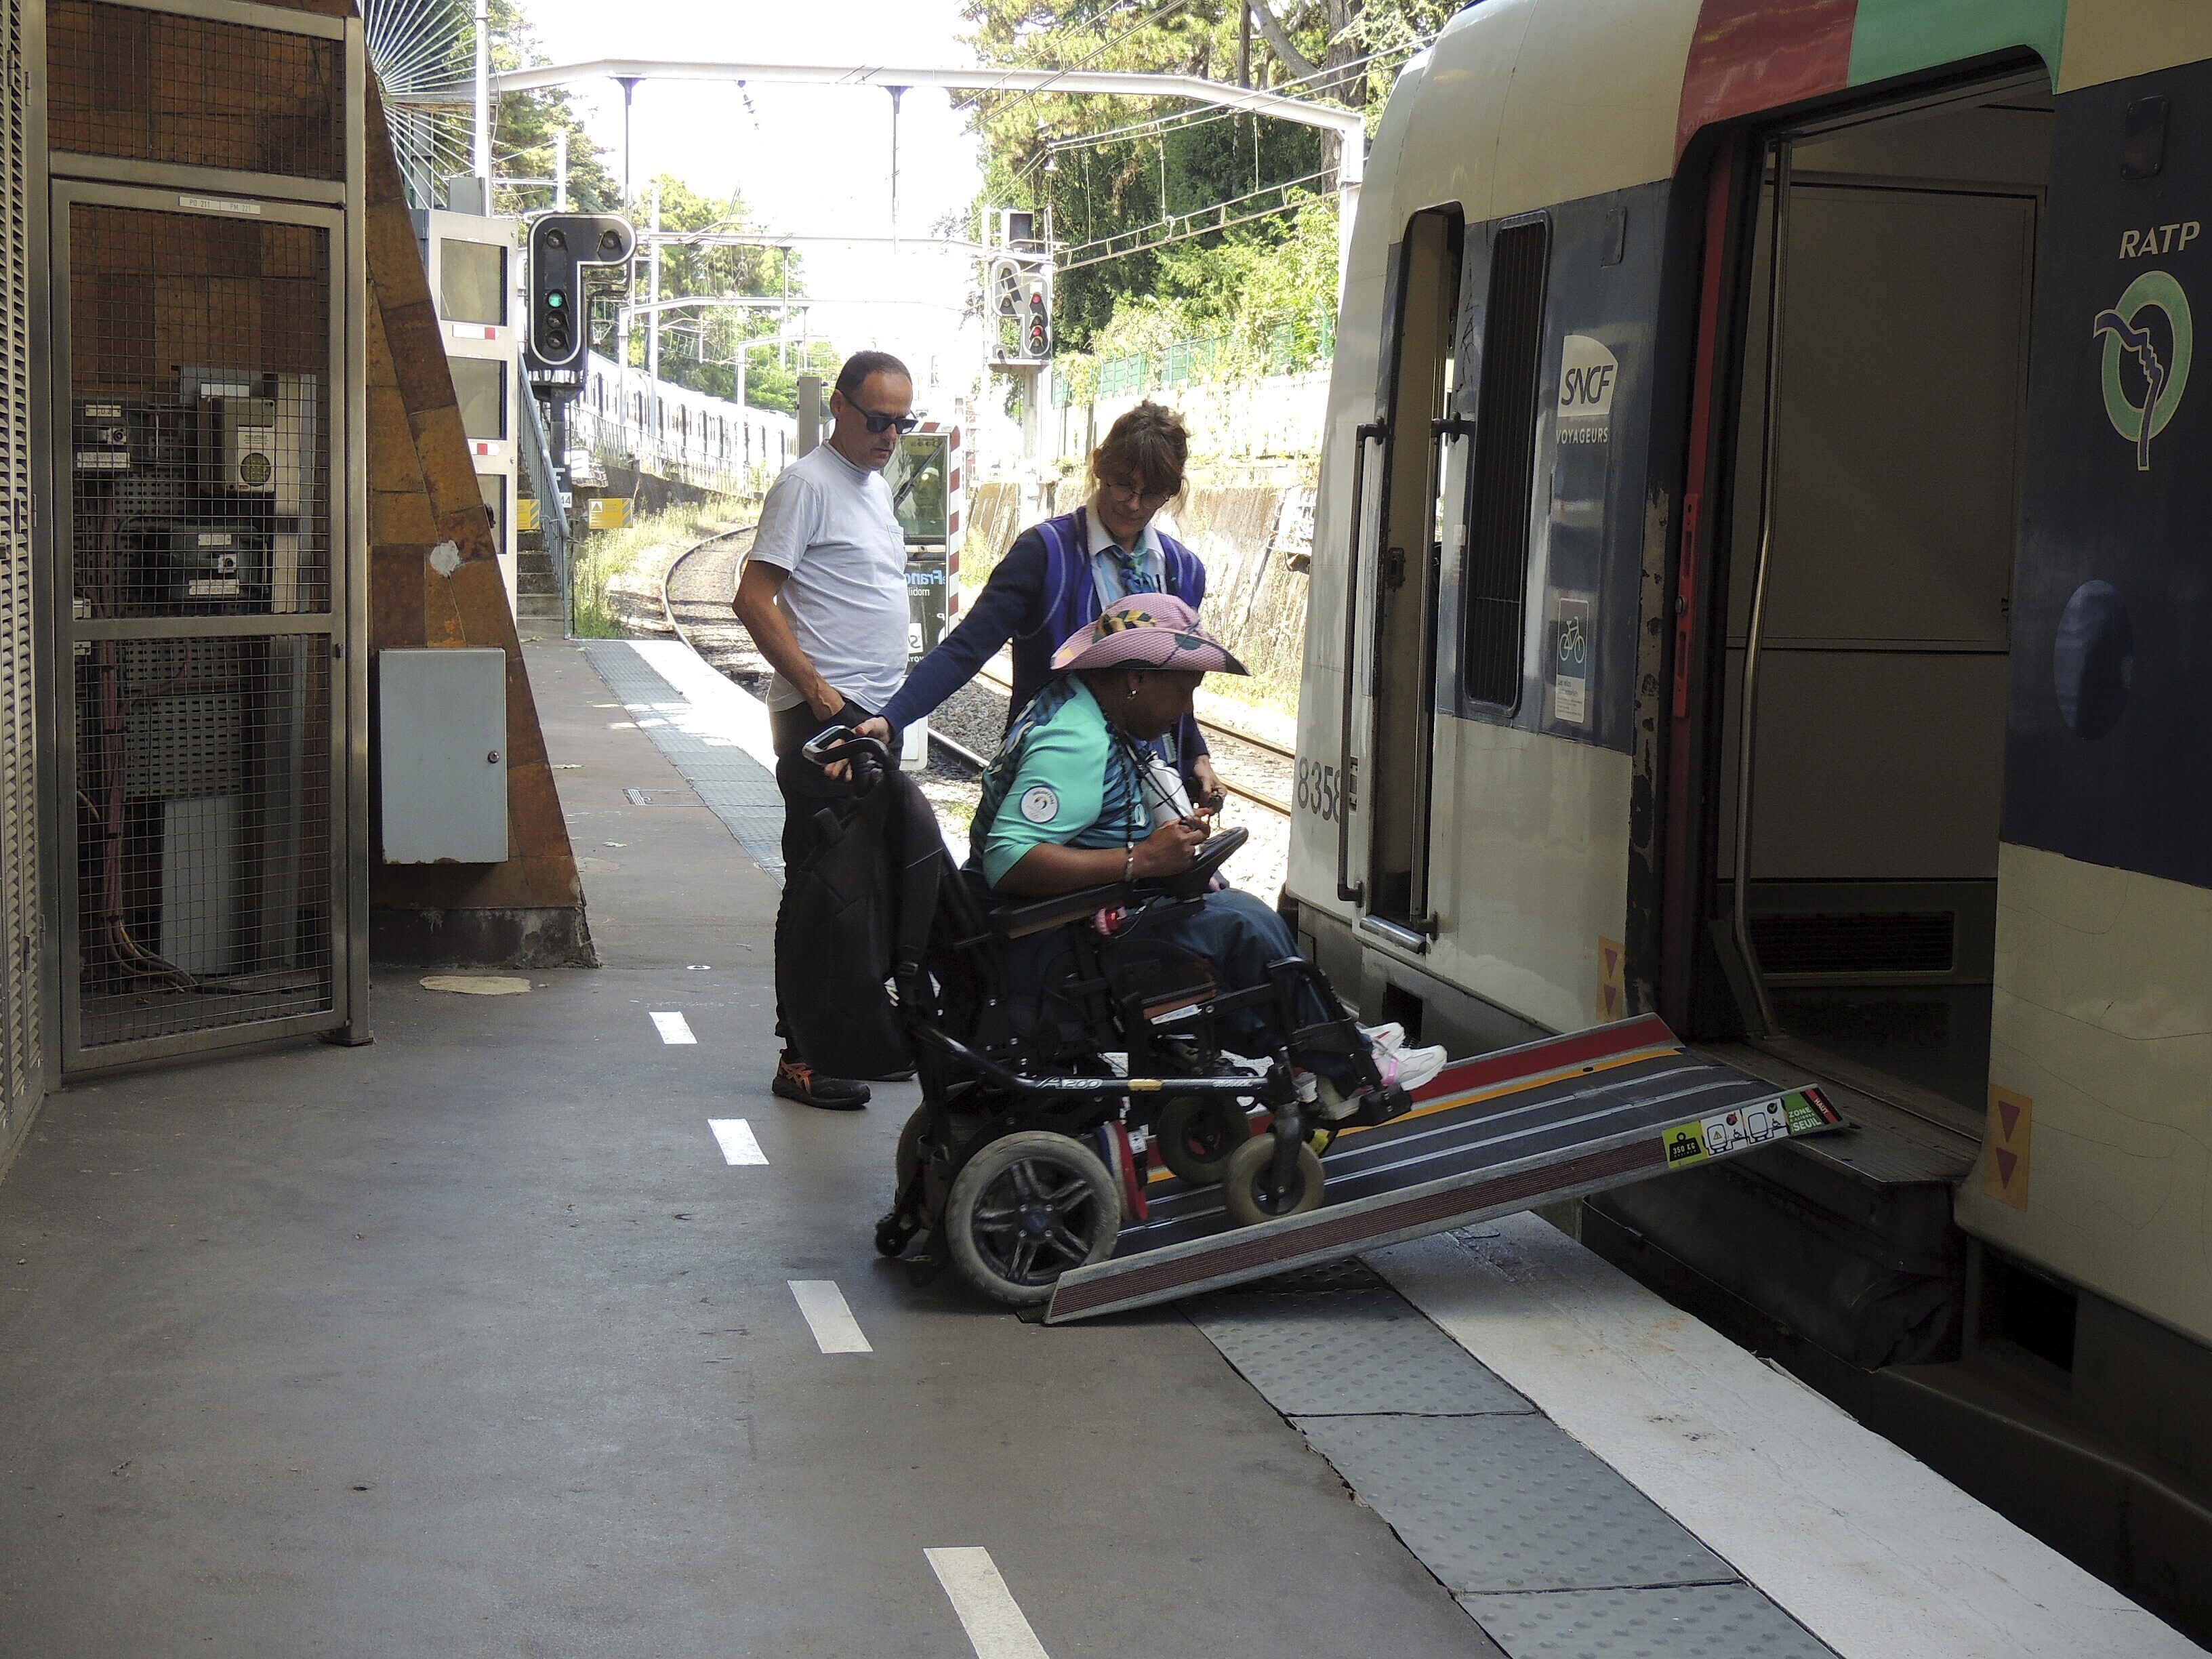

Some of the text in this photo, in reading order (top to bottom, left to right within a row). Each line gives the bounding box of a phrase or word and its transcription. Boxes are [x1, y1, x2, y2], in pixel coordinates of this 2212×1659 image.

[2119, 221, 2200, 260] RATP
[1561, 365, 1614, 406] SNCF
[1556, 427, 1608, 445] VOYAGEURS
[1788, 1107, 1812, 1118] ZONE
[1814, 1098, 1828, 1114] HAUT
[1793, 1117, 1822, 1132] SEUIL
[1673, 1145, 1685, 1155] 350
[1687, 1142, 1696, 1150] KG
